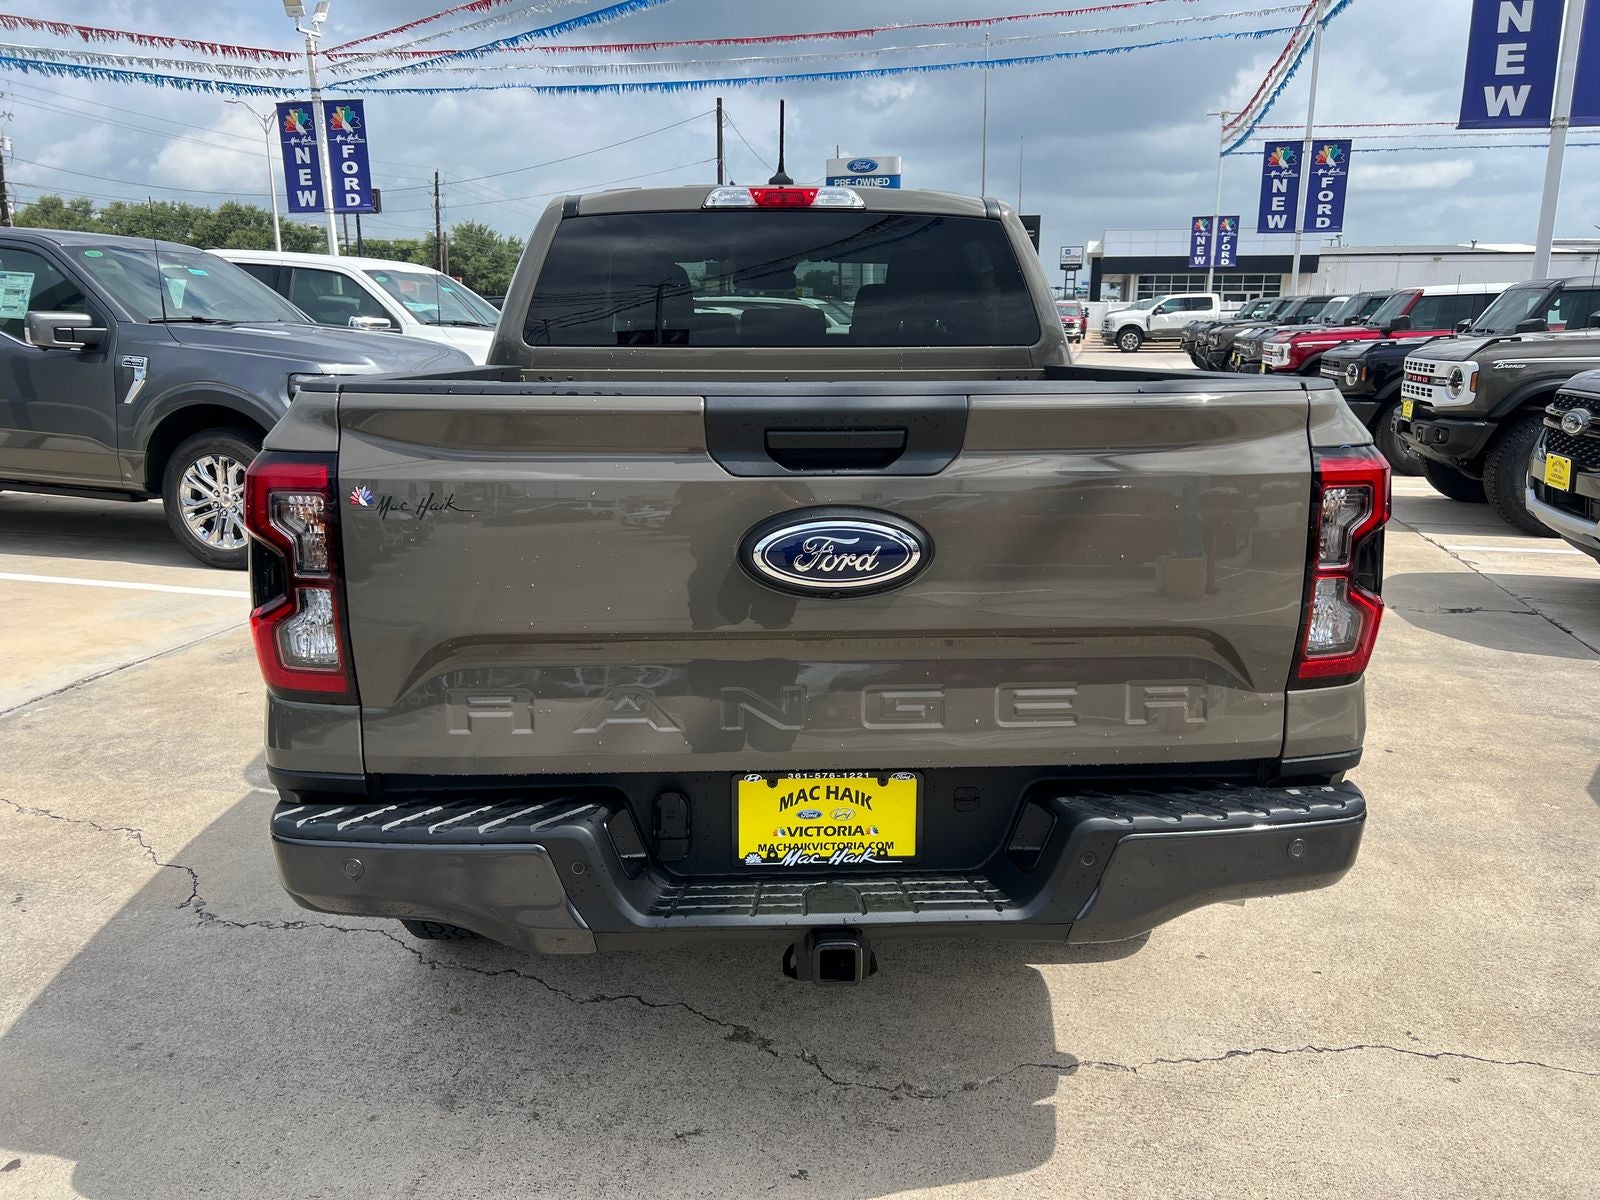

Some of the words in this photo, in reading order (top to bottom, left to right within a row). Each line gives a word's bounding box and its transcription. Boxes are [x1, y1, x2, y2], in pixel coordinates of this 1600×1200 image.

[1484, 0, 1534, 117] NEW
[295, 147, 317, 207] NEW
[341, 145, 361, 207] FORD
[834, 177, 890, 187] PRE-OWNED
[1267, 178, 1288, 229] NEW
[1315, 177, 1334, 229] FORD
[1193, 236, 1206, 265] NEW
[1220, 236, 1231, 265] FORD
[1493, 361, 1527, 370] Bronco
[376, 495, 412, 520] Mac
[416, 492, 466, 520] Haik
[793, 536, 882, 572] Ford
[446, 680, 1207, 735] RANGER
[779, 785, 821, 812] MAC
[825, 785, 873, 811] HAIK
[786, 825, 865, 837] VICTORIA
[757, 841, 895, 852] MACHAIKVICTORIA.COM
[783, 850, 823, 866] Mac
[827, 847, 880, 866] Haik
